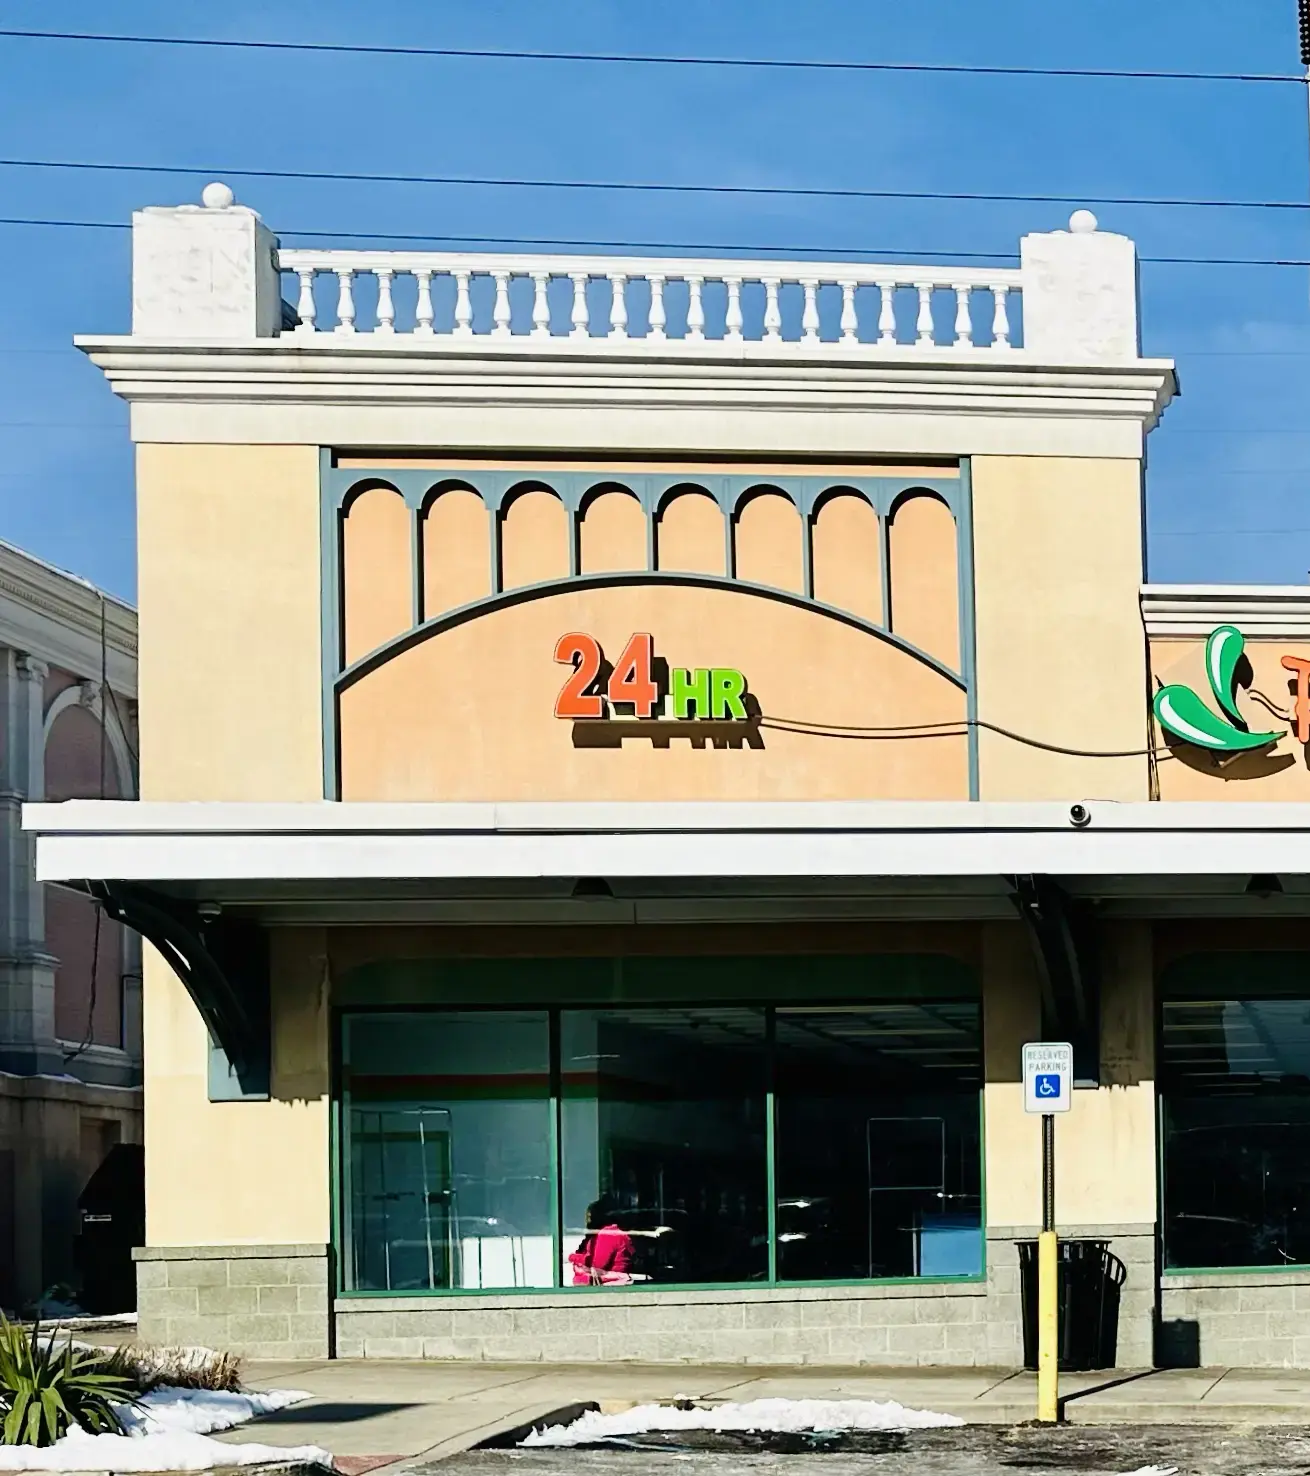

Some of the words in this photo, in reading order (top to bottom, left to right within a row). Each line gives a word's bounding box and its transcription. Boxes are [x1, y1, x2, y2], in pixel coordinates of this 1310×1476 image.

[554, 632, 658, 718] 24
[673, 668, 748, 719] HR
[1029, 1062, 1067, 1071] PARKING
